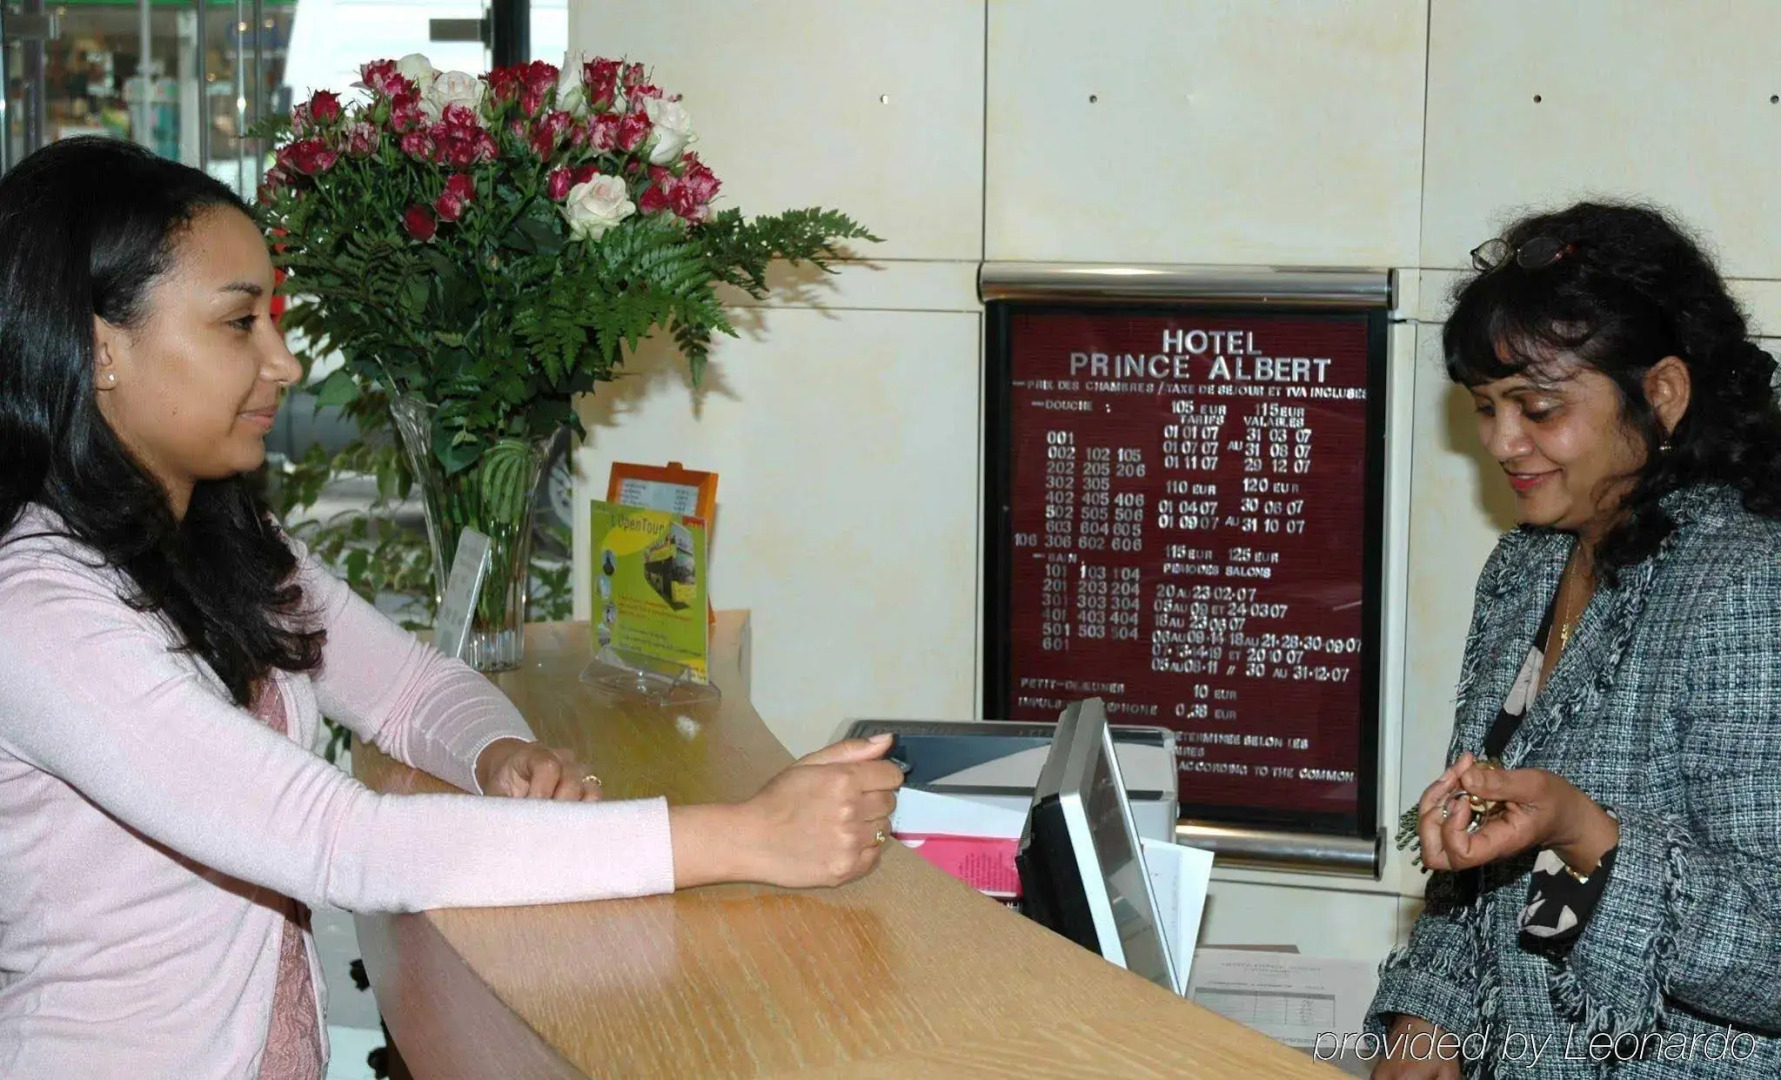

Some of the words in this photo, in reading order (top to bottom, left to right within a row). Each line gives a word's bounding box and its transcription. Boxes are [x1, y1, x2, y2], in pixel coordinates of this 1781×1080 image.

[1162, 329, 1262, 355] HOTEL
[1070, 352, 1191, 379] PRINCE
[1208, 356, 1332, 383] ALBERT
[1058, 380, 1080, 392] DES
[1085, 381, 1155, 395] CHAMBRES
[1198, 385, 1215, 393] DE
[1268, 386, 1281, 398] ET
[1286, 387, 1308, 399] TVA
[1171, 400, 1195, 415] 105
[1200, 404, 1227, 416] EUR
[1255, 402, 1279, 417] 115
[1280, 406, 1305, 418] EUR
[1180, 414, 1225, 426] TARIFS
[1243, 415, 1305, 429] VALABLES
[1046, 430, 1075, 446] 001
[1163, 425, 1179, 440] 01
[1182, 425, 1198, 440] 01
[1201, 426, 1219, 441] 07
[1269, 428, 1288, 443] 03
[1295, 428, 1313, 444] 07
[1047, 446, 1076, 461] 002
[1086, 447, 1111, 462] 102
[1117, 448, 1142, 463] 105
[1201, 442, 1219, 456] 07
[1227, 440, 1243, 451] AU
[1294, 444, 1313, 460] 07
[1046, 461, 1075, 475] 202
[1082, 462, 1110, 477] 205
[1116, 463, 1146, 478] 206
[1201, 456, 1219, 472] 07
[1272, 459, 1288, 474] 12
[1293, 459, 1312, 475] 07
[1045, 476, 1074, 490] 302
[1082, 477, 1110, 492] 305
[1166, 480, 1189, 494] 110
[1192, 484, 1217, 496] EUR
[1242, 477, 1269, 493] 120
[1273, 482, 1300, 494] EUR
[1081, 492, 1110, 506] 405
[1113, 493, 1145, 507] 406
[1178, 500, 1198, 515] 04
[1200, 501, 1219, 516] 07
[1240, 497, 1260, 513] 30
[1286, 499, 1305, 516] 07
[1045, 504, 1074, 519] 502
[1114, 508, 1144, 522] 506
[1200, 516, 1220, 531] 07
[1264, 518, 1280, 533] 10
[1286, 519, 1306, 534] 07
[1187, 548, 1213, 561] EUR
[1253, 551, 1280, 564] EUR
[1225, 566, 1271, 579] SALONS
[1078, 580, 1108, 595] 203
[1111, 581, 1140, 596] 204
[1109, 611, 1140, 625] 404
[1272, 667, 1288, 679] AU
[1193, 684, 1209, 699] 10
[1213, 688, 1238, 700] EUR
[1213, 708, 1238, 720] EUR
[1243, 735, 1283, 749] SELON
[1178, 761, 1249, 776] ACCORDING
[1254, 765, 1270, 777] TO
[1273, 767, 1295, 779] THE
[1298, 767, 1356, 784] COMMON
